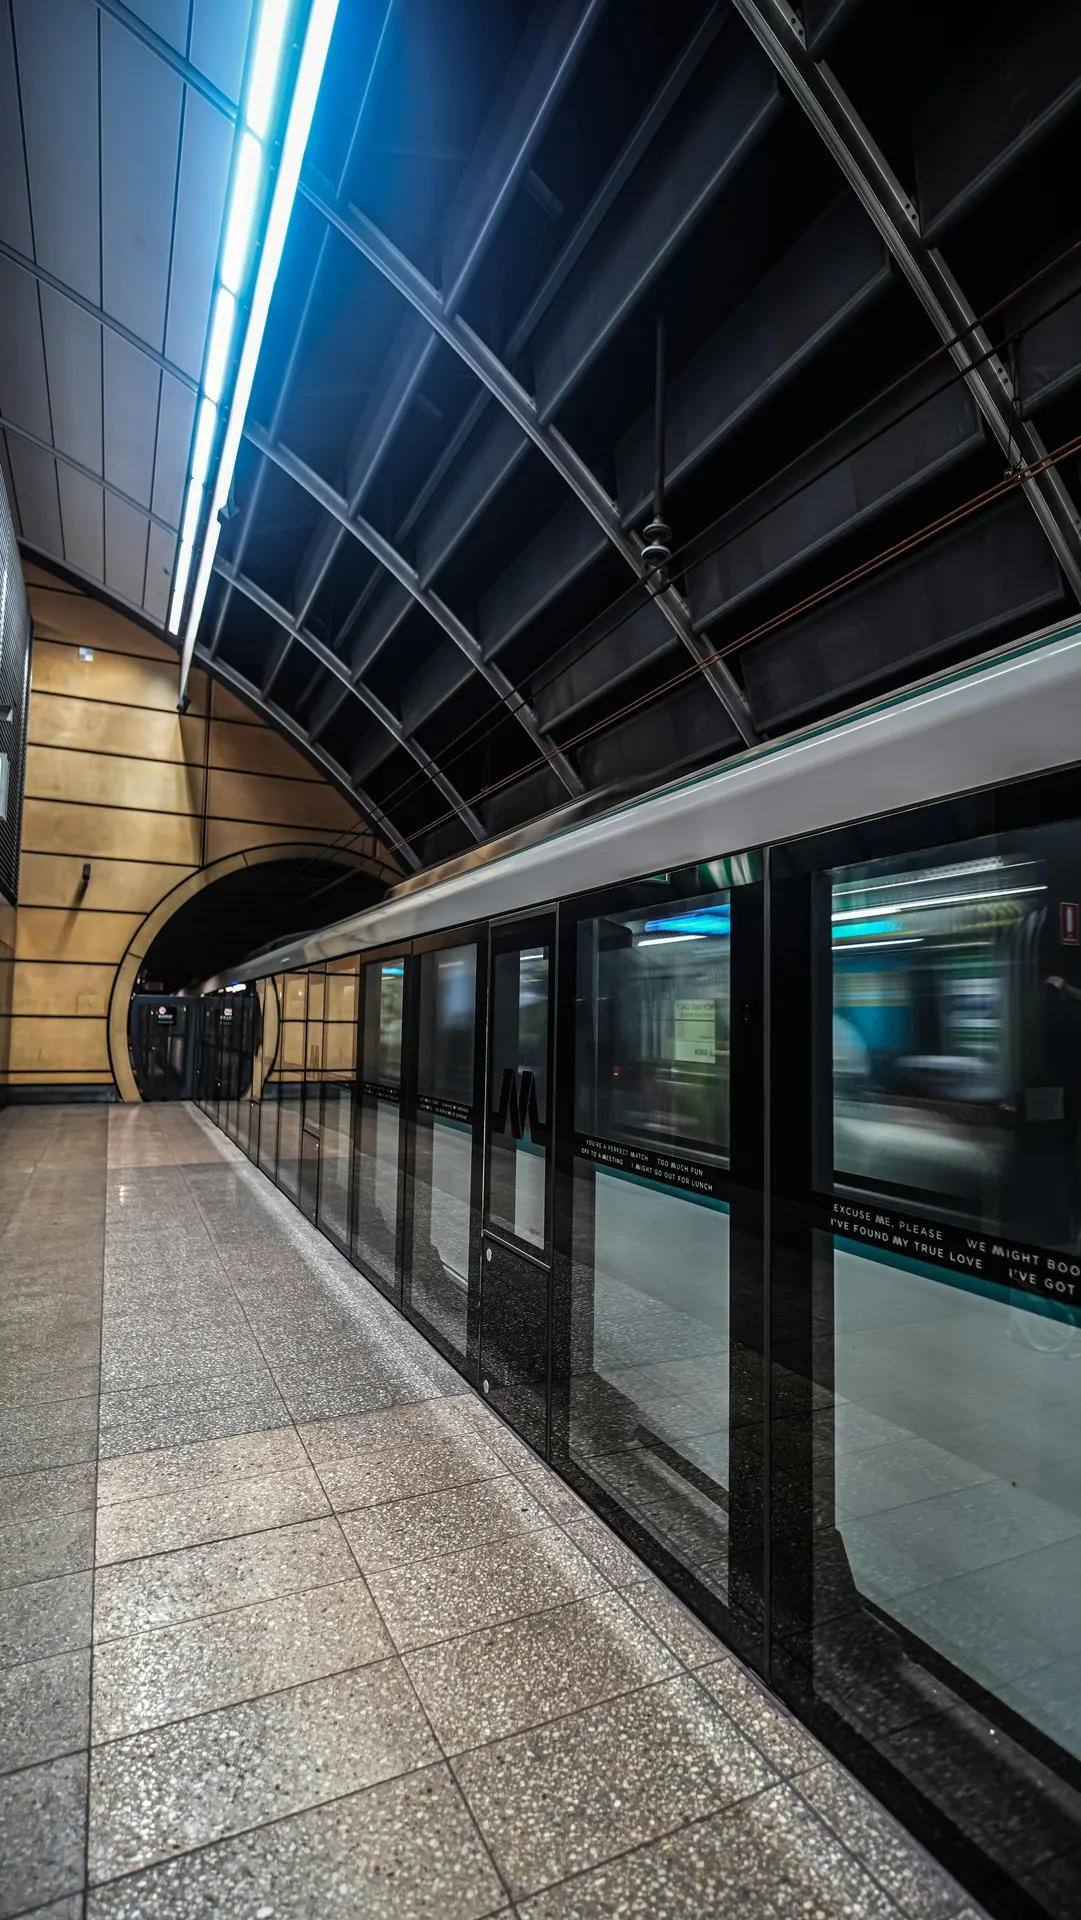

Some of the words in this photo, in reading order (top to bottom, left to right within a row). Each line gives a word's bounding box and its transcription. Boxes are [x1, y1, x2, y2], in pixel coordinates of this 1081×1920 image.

[581, 1147, 589, 1155] OFF
[602, 1153, 624, 1165] MEETING
[635, 1163, 652, 1173] MIGHT
[654, 1169, 662, 1177] GO
[664, 1172, 675, 1180] OUT
[678, 1175, 690, 1185] FOR
[691, 1179, 713, 1191] LUNCH
[586, 1140, 601, 1149] YOU'RE
[603, 1142, 606, 1150] A
[608, 1145, 628, 1156] PERFECT
[630, 1151, 648, 1161] MATCH
[657, 1158, 668, 1167] TOO
[671, 1162, 689, 1173] MUCH
[690, 1166, 703, 1176] FUN
[830, 1218, 849, 1231] I'VE
[853, 1224, 889, 1242] FOUND
[892, 1236, 909, 1248] MY
[914, 1241, 944, 1259] TRUE
[950, 1252, 983, 1269] LOVE
[1008, 1268, 1037, 1285] I'VE
[1044, 1277, 1075, 1295] GOT
[833, 1203, 871, 1221] EXCUSE
[875, 1214, 894, 1229] ME,
[900, 1221, 943, 1241] PLEASE
[966, 1238, 986, 1252] WE
[991, 1245, 1040, 1266] MIGHT
[1047, 1259, 1081, 1277] BOO
